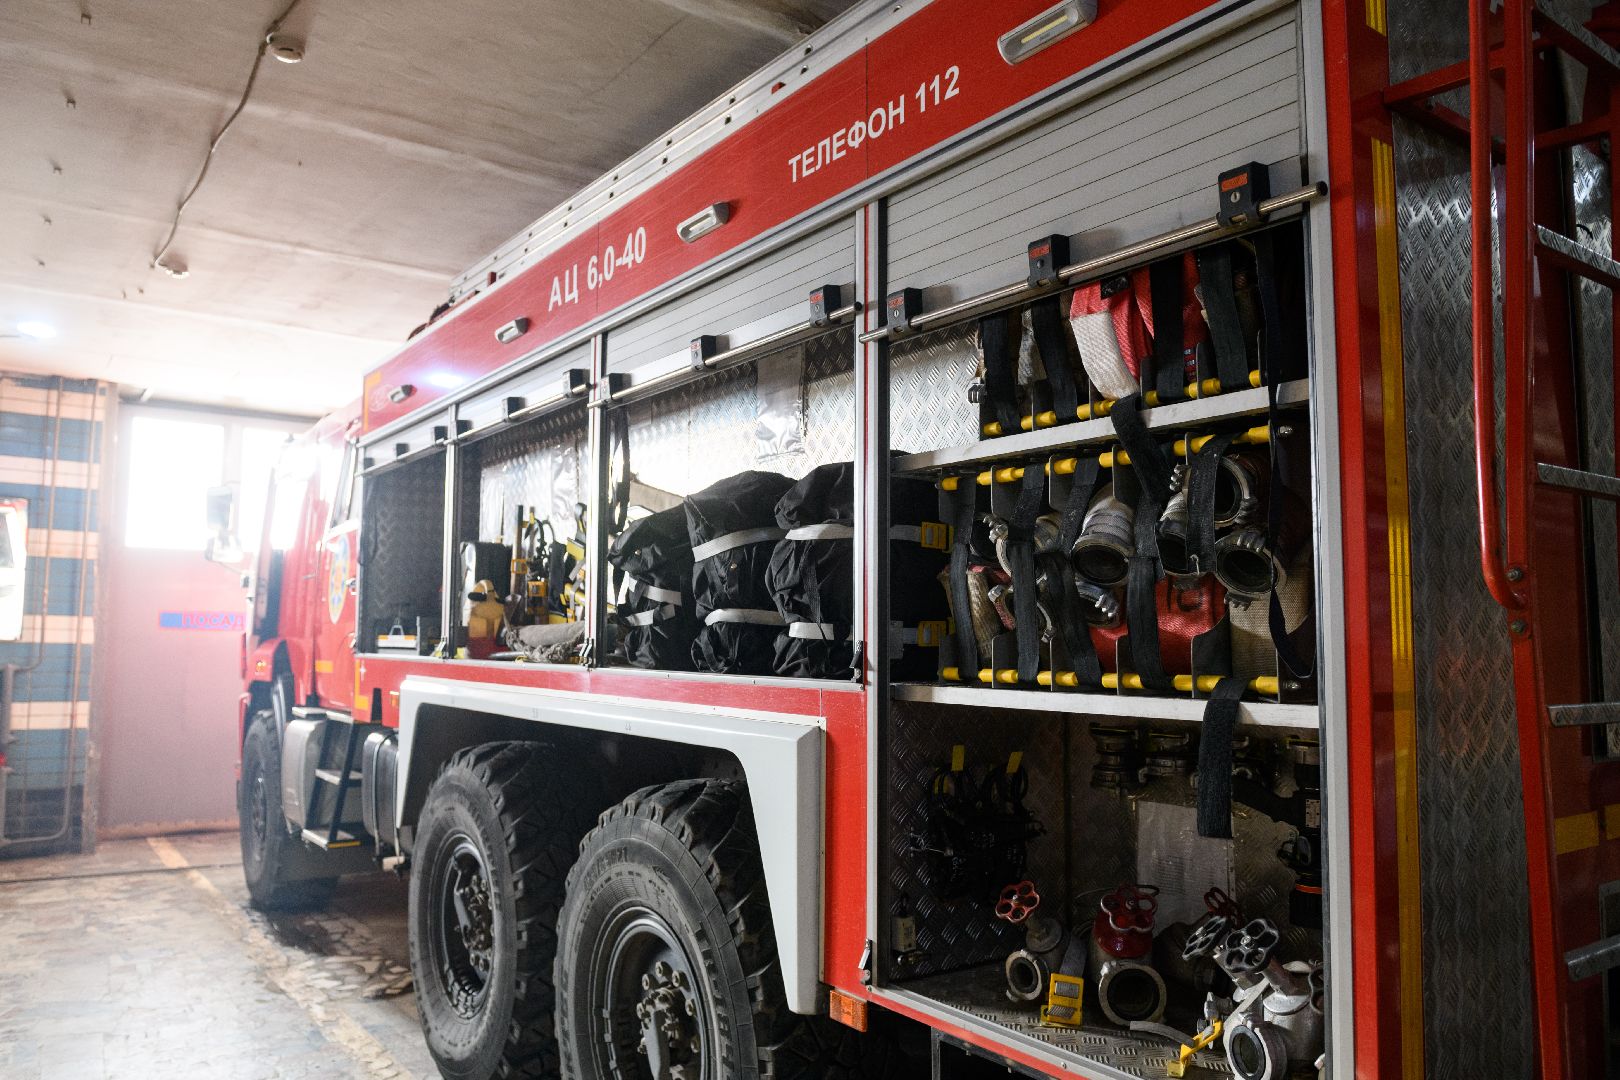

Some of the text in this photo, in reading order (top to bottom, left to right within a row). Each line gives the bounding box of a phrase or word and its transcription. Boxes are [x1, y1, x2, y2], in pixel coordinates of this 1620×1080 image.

[788, 65, 960, 183] ТЕЛЕФОН 112
[548, 226, 647, 312] АЦ 6,0-40
